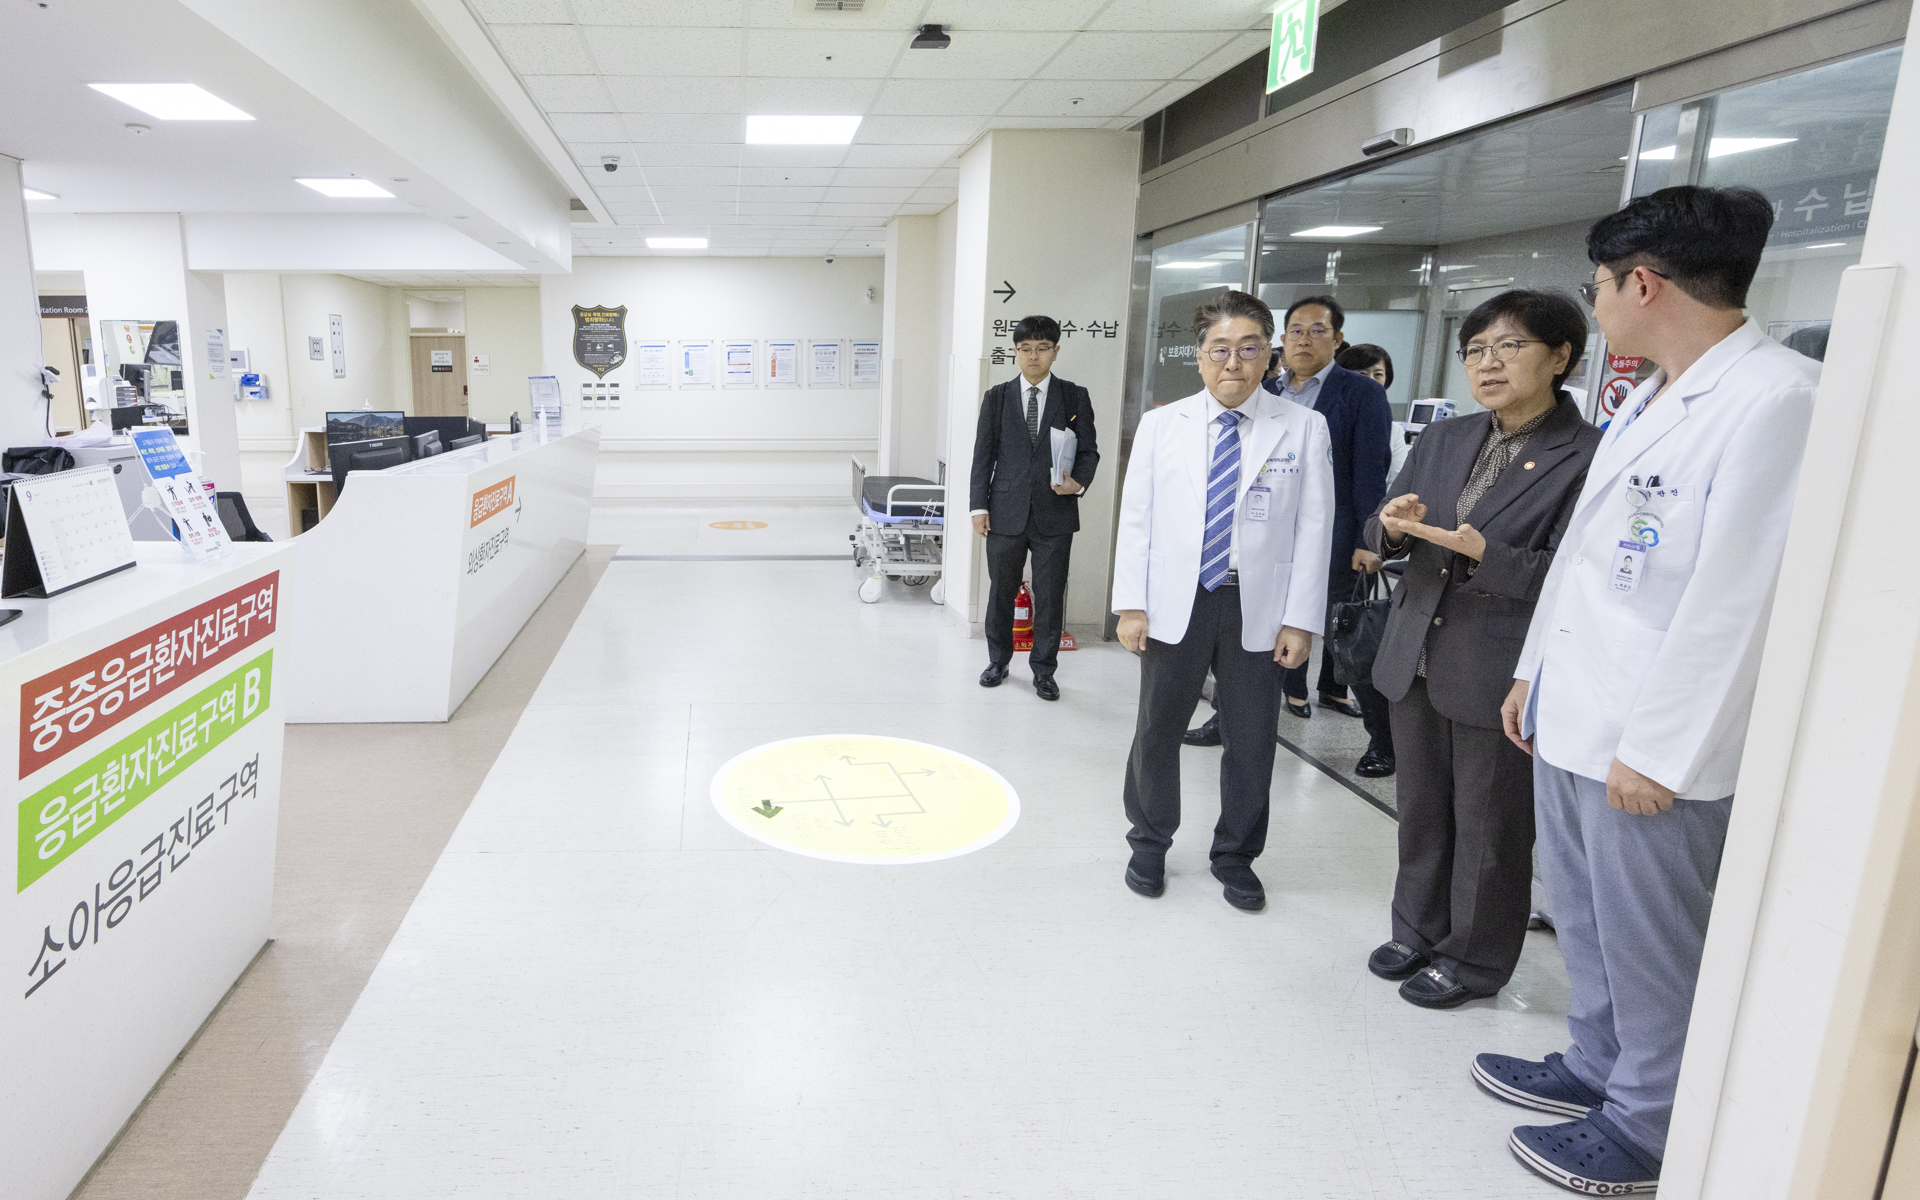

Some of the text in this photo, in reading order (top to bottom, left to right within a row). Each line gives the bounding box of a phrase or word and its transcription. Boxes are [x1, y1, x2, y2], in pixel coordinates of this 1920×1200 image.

[1781, 221, 1850, 239] Hospitalization
[64, 306, 84, 314] Room
[1612, 359, 1639, 369] 충돌주의
[25, 490, 33, 502] 9
[29, 583, 274, 754] 중증응급환자진료구역
[34, 666, 261, 861] 응급환자진료구역 B
[24, 752, 260, 1000] 소아응급진료구역
[1568, 1176, 1634, 1194] crocs
